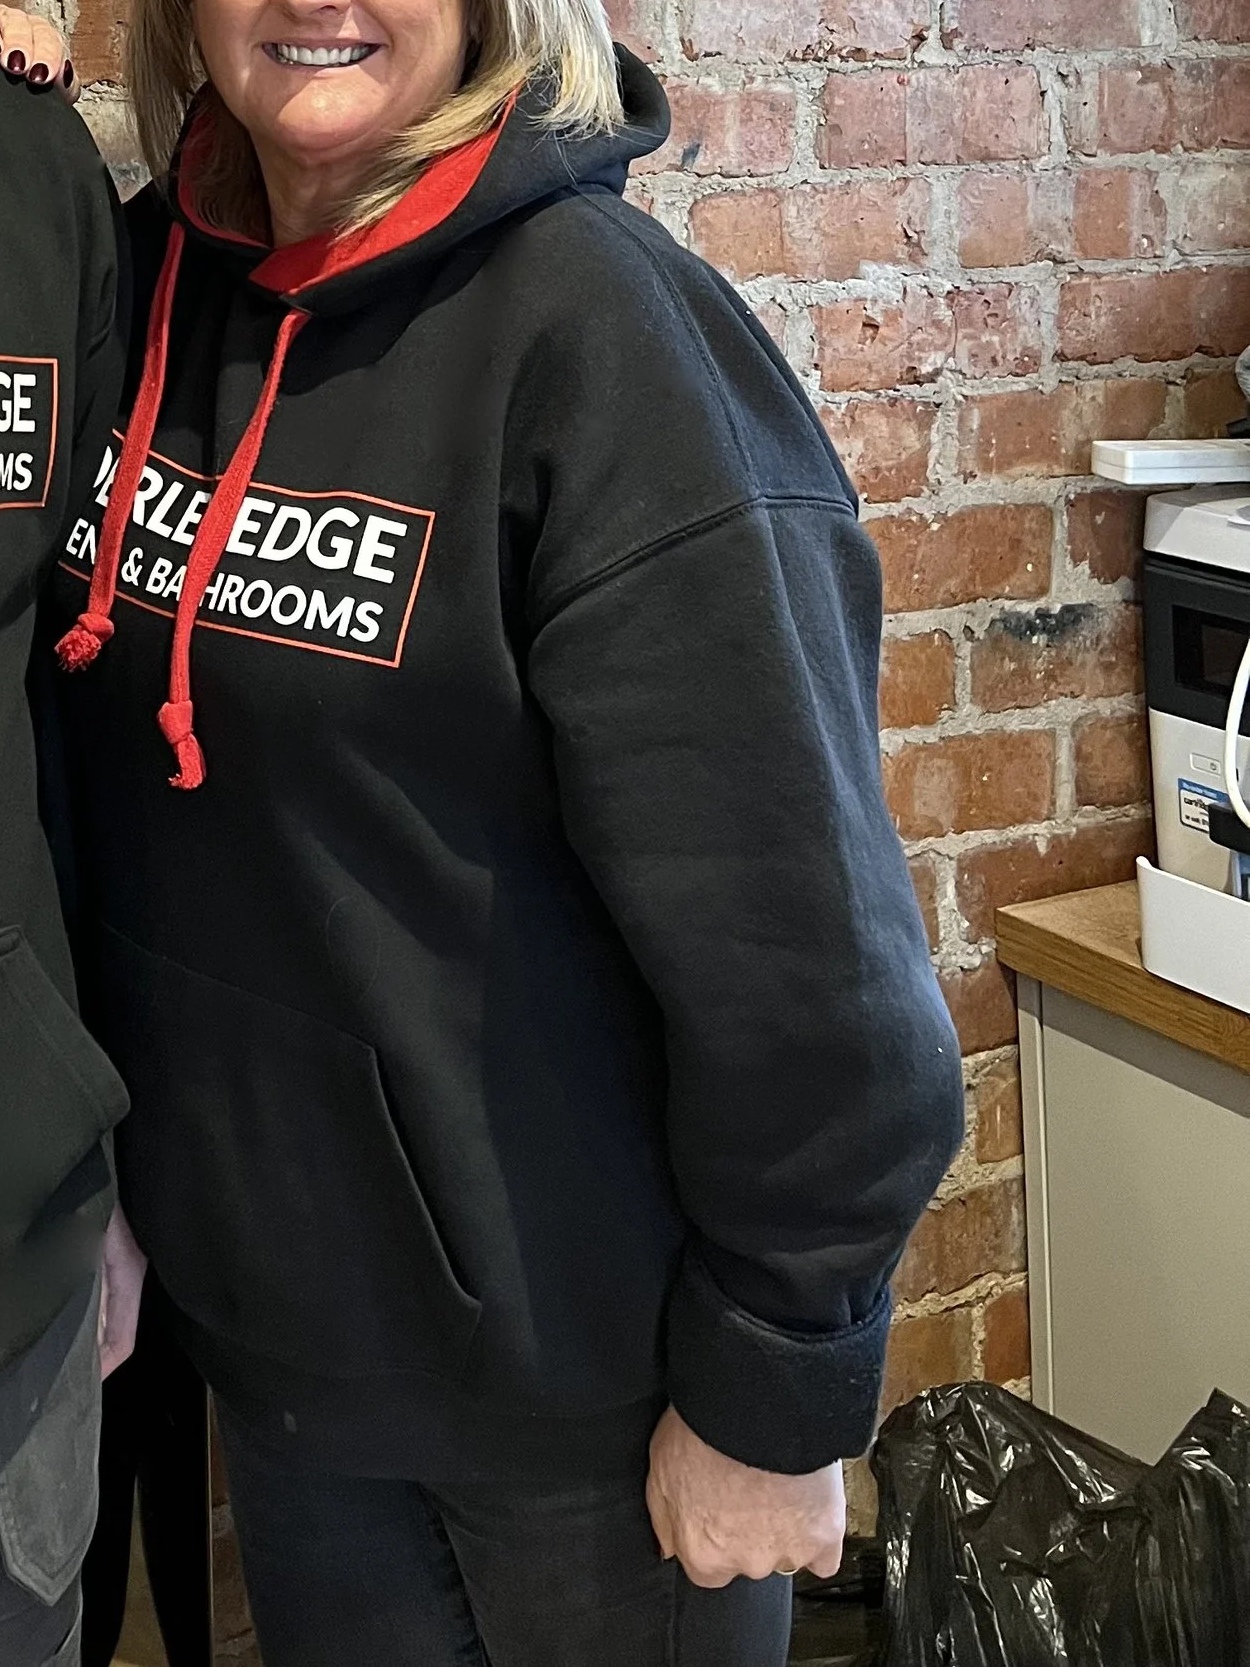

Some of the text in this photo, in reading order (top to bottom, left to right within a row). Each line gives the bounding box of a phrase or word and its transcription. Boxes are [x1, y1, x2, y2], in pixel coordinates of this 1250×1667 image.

[224, 494, 409, 585] EDGE
[120, 546, 144, 588] &
[144, 555, 385, 644] BAHROOMS
